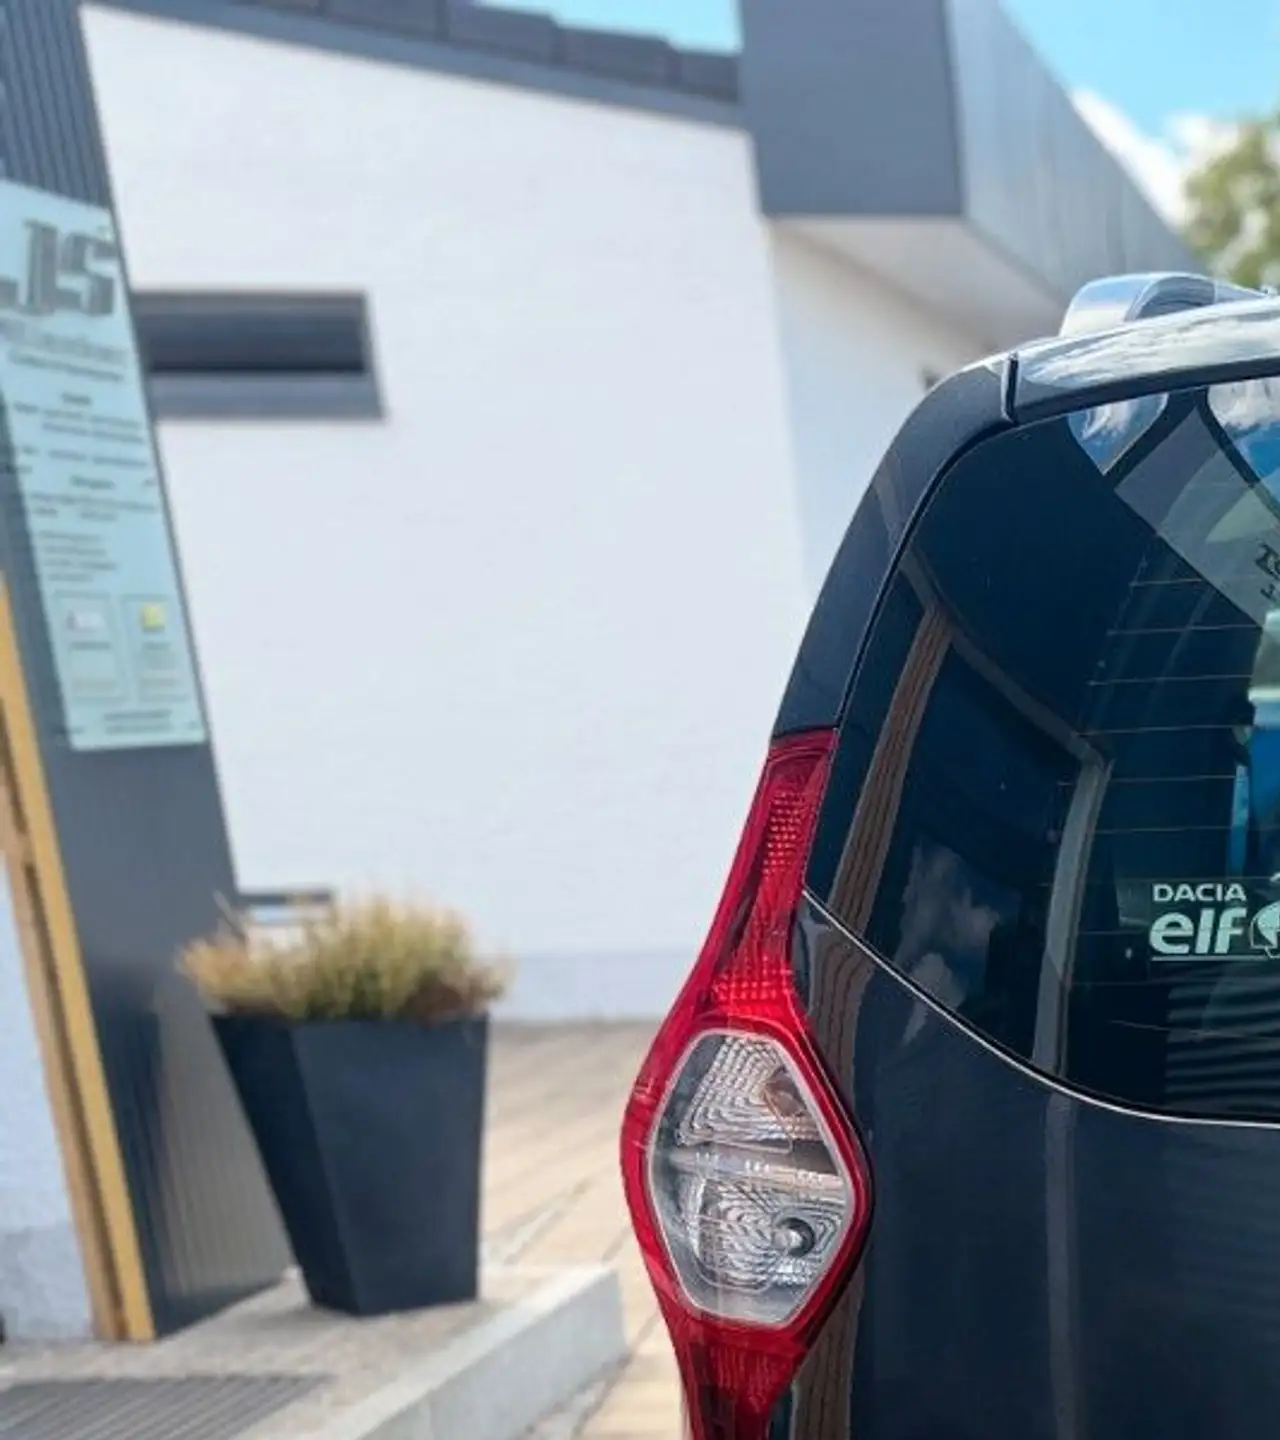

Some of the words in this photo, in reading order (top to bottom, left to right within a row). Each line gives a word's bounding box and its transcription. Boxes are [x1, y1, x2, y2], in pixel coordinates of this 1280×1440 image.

[0, 218, 118, 318] JS
[1152, 883, 1247, 902] DACIA
[1149, 907, 1248, 955] elf
